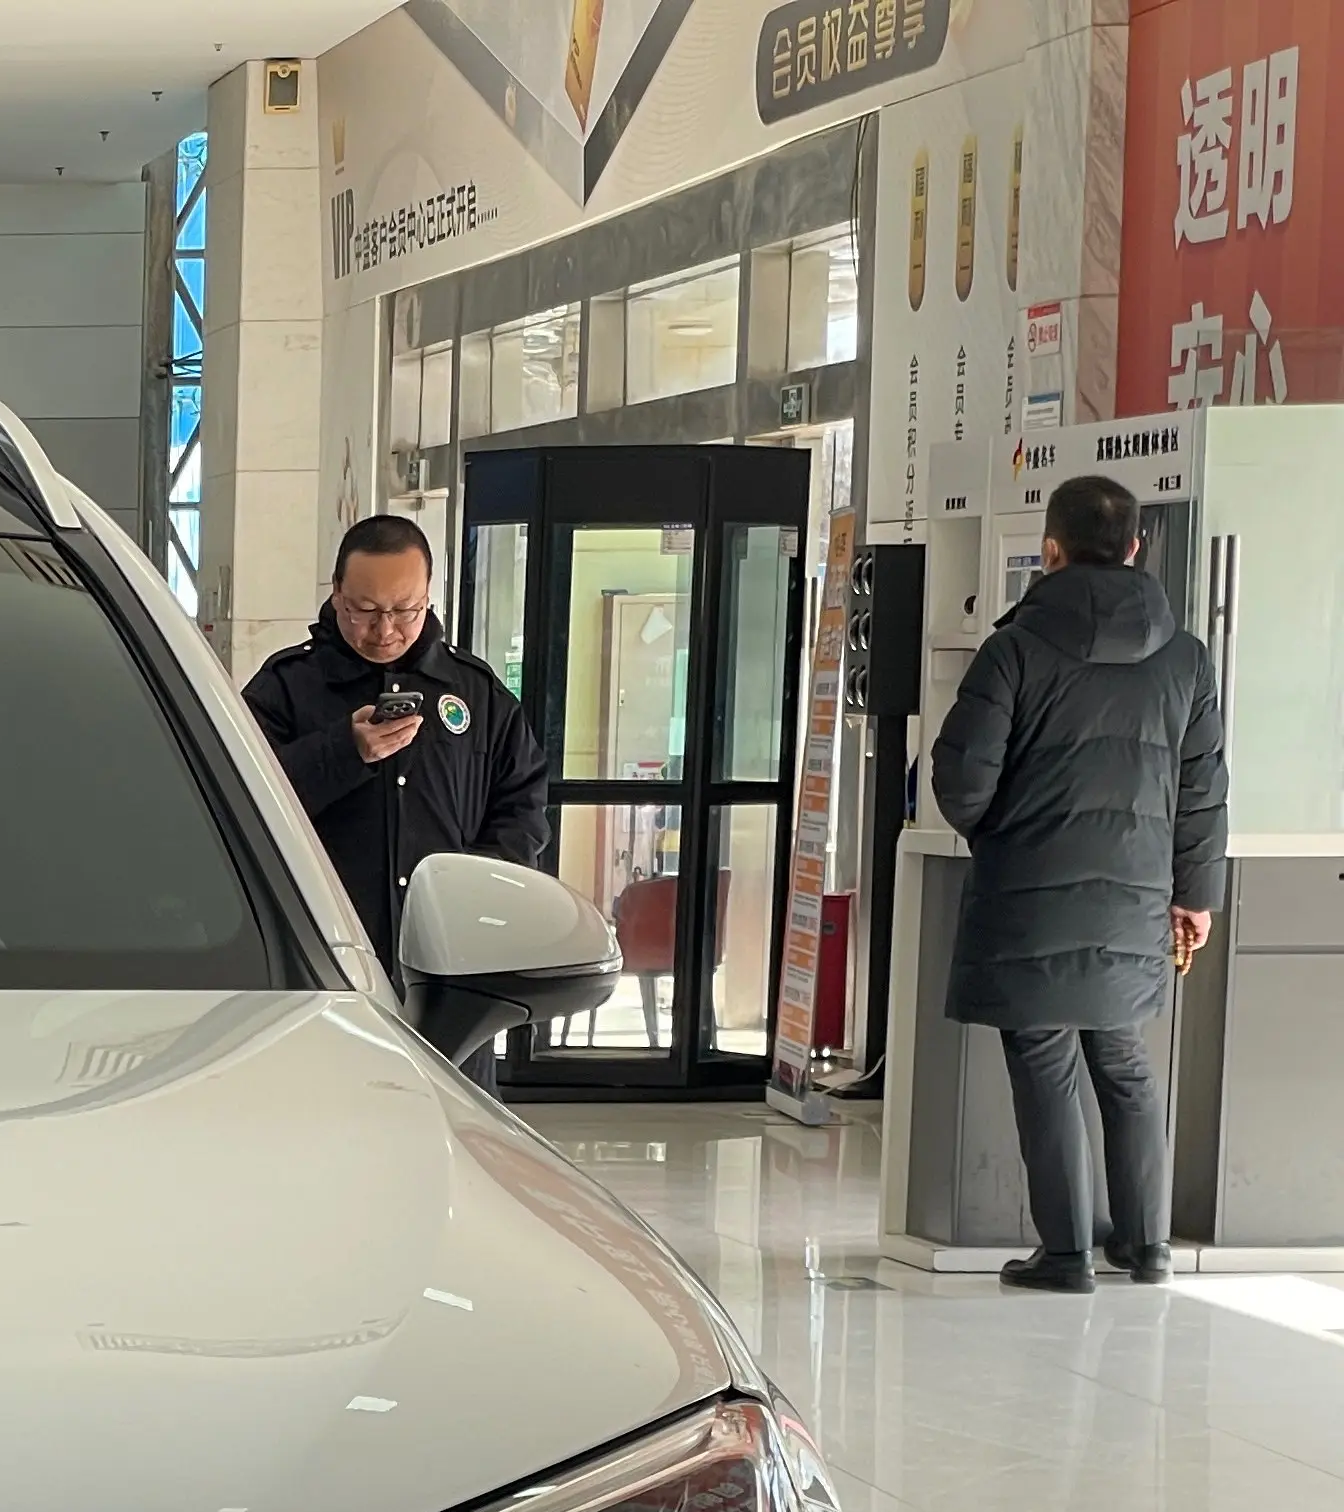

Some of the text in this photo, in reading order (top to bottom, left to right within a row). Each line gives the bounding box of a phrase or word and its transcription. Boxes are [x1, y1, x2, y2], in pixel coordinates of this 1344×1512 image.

[773, 0, 925, 99] 会员权益尊享
[1174, 45, 1298, 250] 透明
[331, 188, 354, 280] VIP
[1168, 290, 1287, 411] 安心
